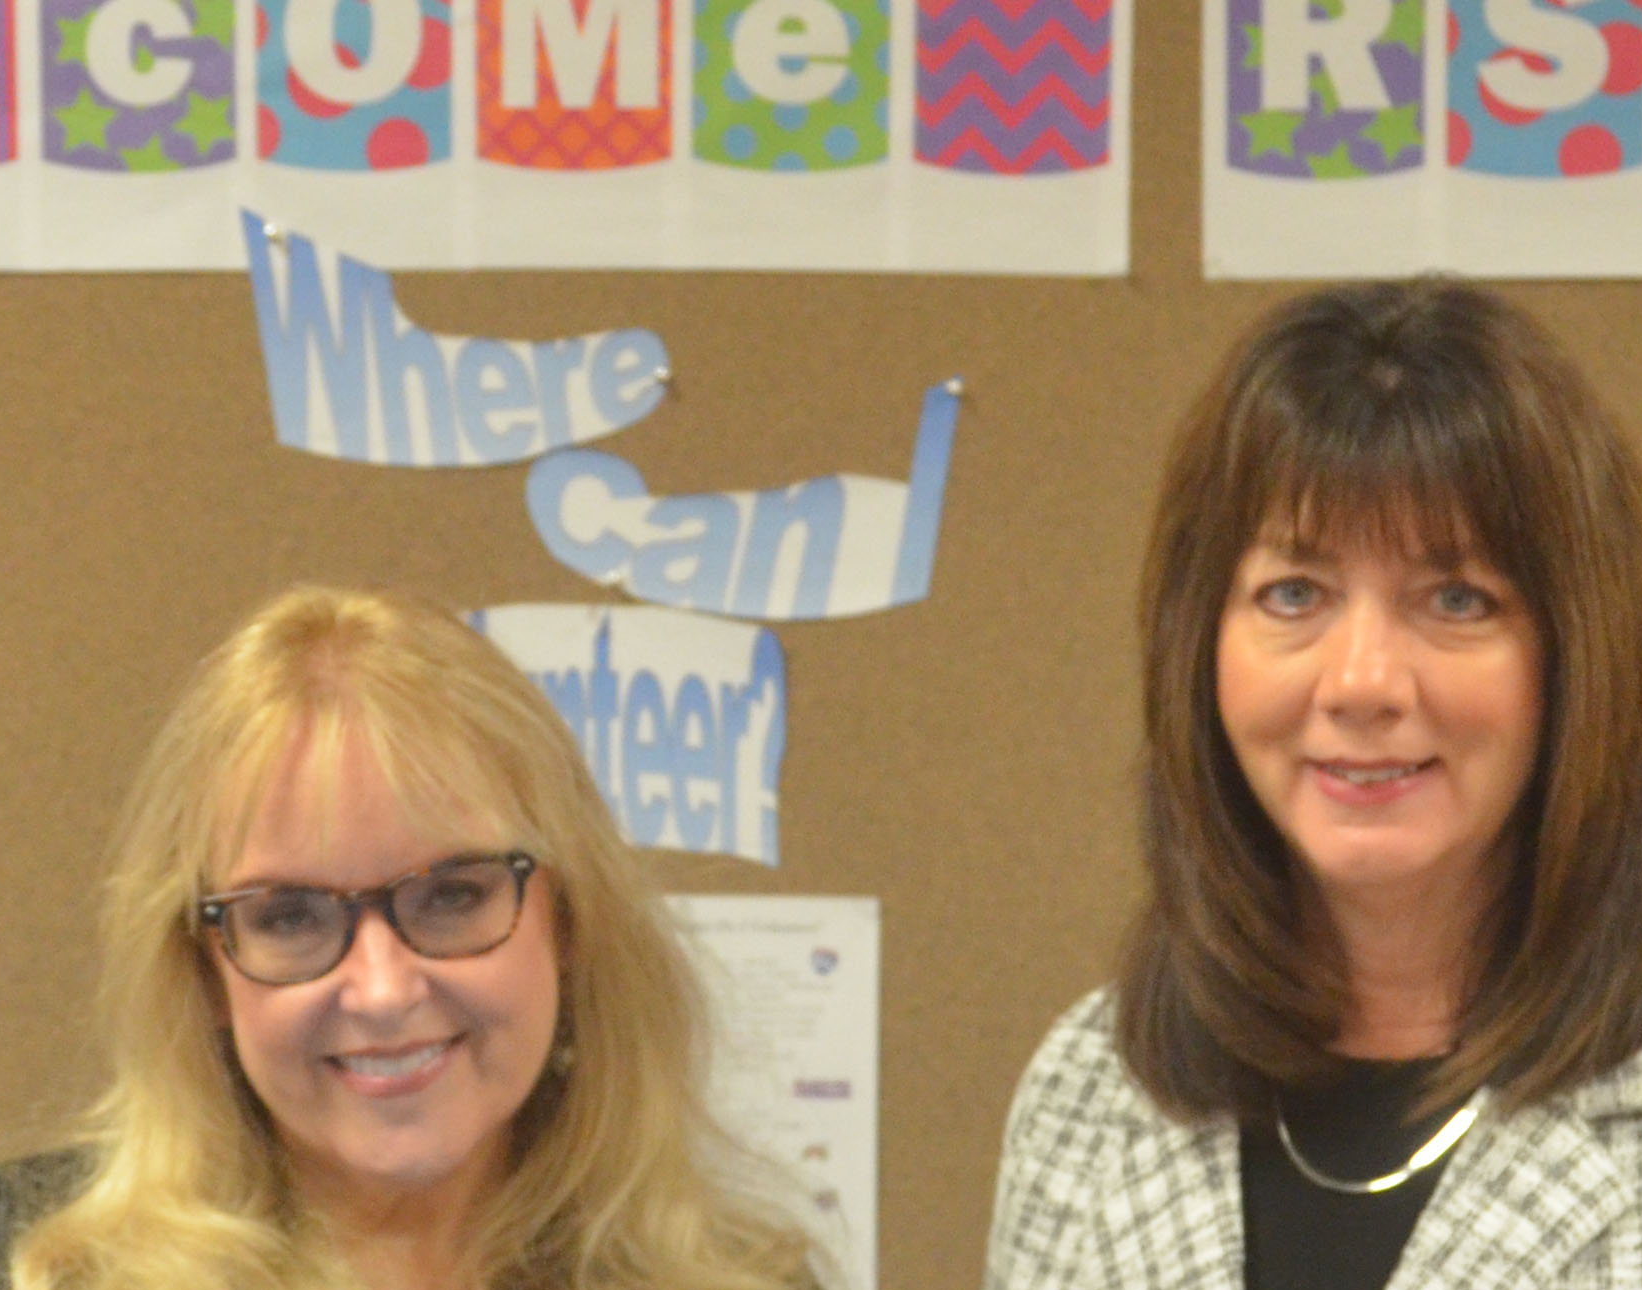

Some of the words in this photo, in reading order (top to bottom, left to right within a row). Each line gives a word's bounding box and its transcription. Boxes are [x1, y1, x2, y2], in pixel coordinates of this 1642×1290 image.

[240, 208, 669, 468] Where
[525, 447, 847, 621] Can
[890, 376, 965, 602] I
